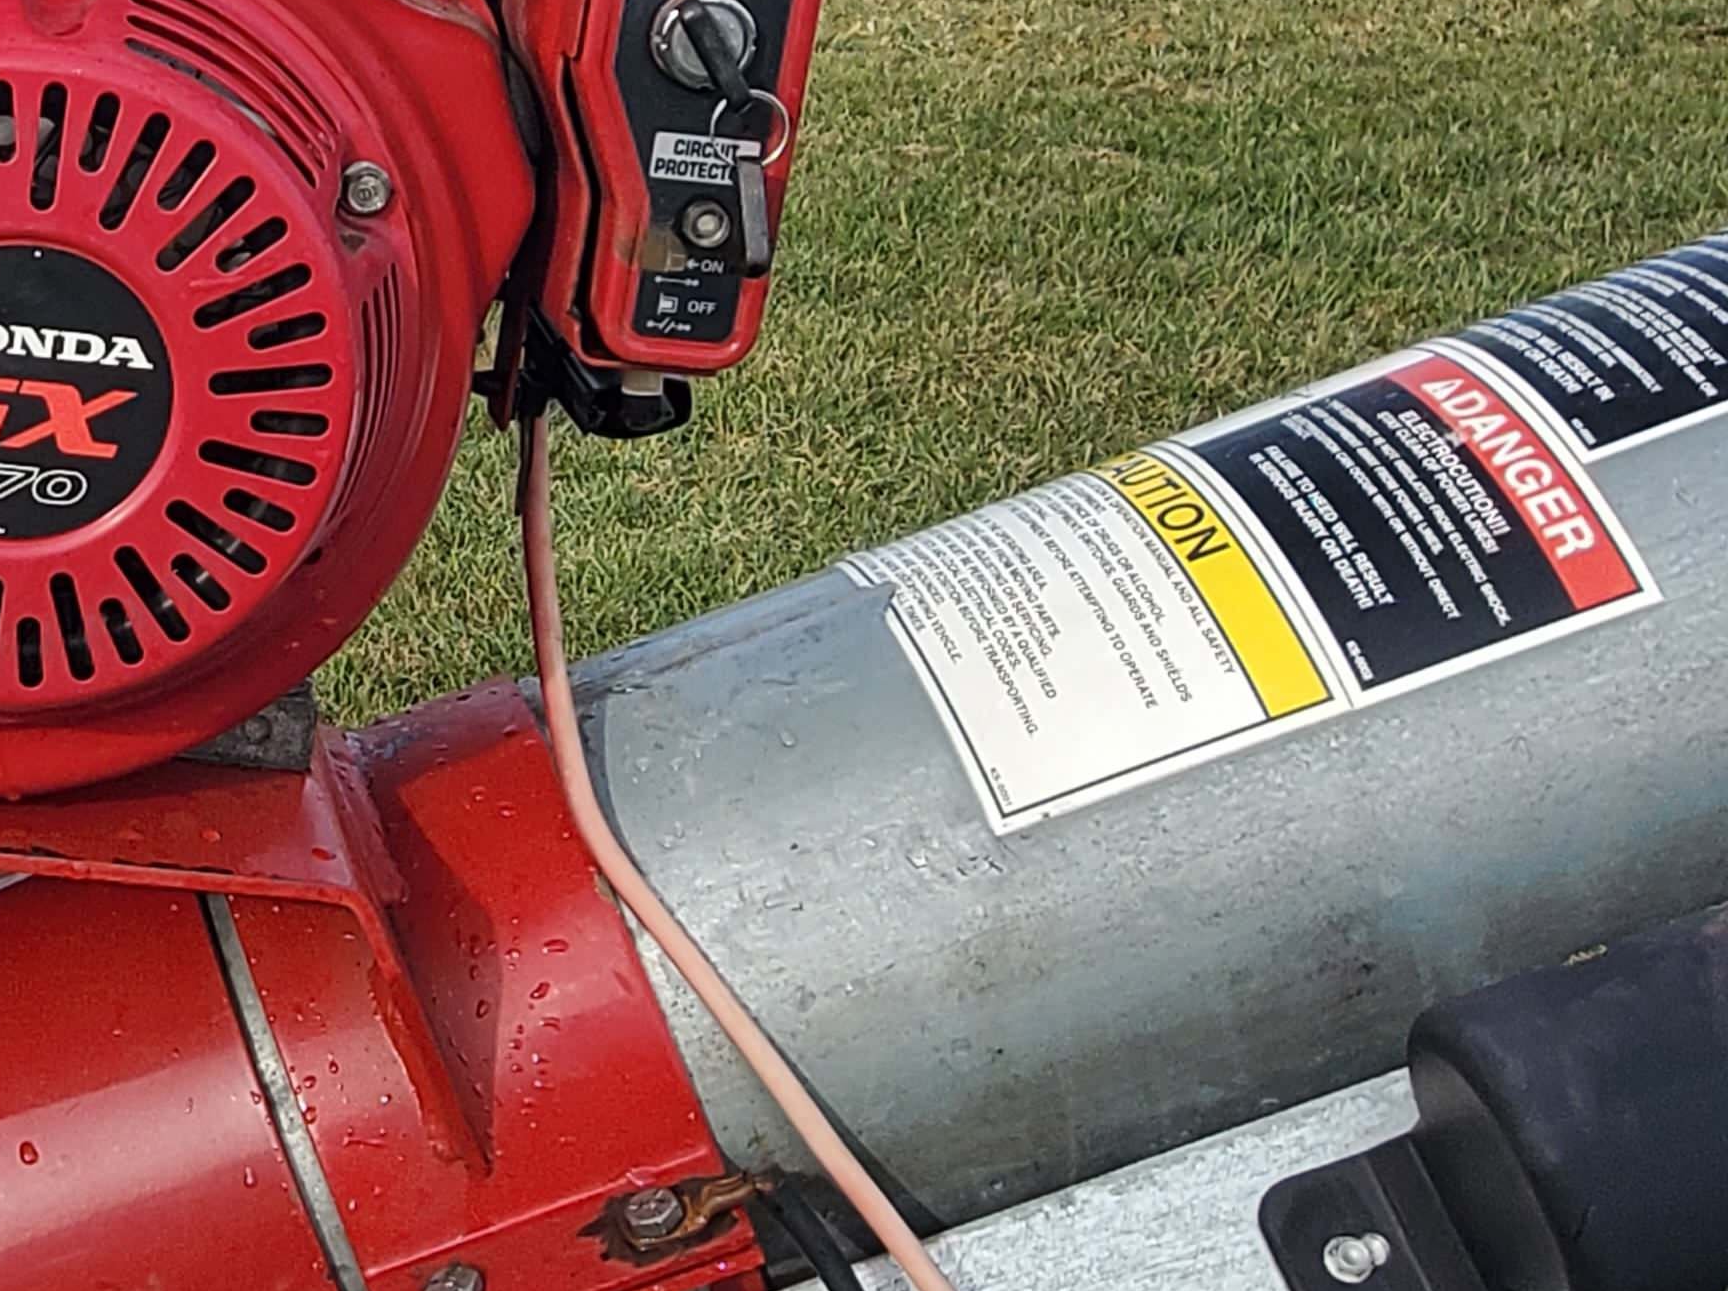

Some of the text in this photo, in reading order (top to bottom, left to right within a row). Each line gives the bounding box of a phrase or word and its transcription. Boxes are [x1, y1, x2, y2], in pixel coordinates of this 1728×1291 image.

[654, 159, 735, 181] PROTECT
[673, 139, 740, 157] CIRCUIT
[688, 301, 717, 314] OFF
[700, 260, 725, 274] ON
[1399, 411, 1510, 535] ELECTROCUTION!!
[1435, 472, 1471, 513] POWER
[1441, 389, 1595, 559] DANGER
[1291, 498, 1329, 537] INJURY
[1321, 539, 1342, 560] OR
[1334, 559, 1373, 608] DEATH!
[1296, 477, 1315, 492] TO
[1332, 521, 1358, 553] WILL
[1352, 553, 1394, 603] RESULT
[957, 578, 996, 628] ELECTRICAL
[992, 630, 1021, 670] CODES.
[1002, 586, 1018, 601] OR
[1012, 601, 1052, 657] SERVICING.
[1010, 568, 1038, 603] MOVING
[1033, 604, 1060, 639] PARTS.
[1117, 557, 1133, 571] OR
[1128, 573, 1165, 623] ALCOHOL.
[1172, 581, 1192, 603] AND
[1188, 606, 1205, 626] ALL
[1201, 628, 1235, 672] SAFETY
[958, 606, 988, 643] BEFORE
[984, 644, 1038, 734] TRANSPORTING.
[1002, 615, 1017, 627] BY
[1011, 631, 1022, 639] A
[1017, 639, 1056, 698] QUALIFIED
[1069, 571, 1114, 633] ATTEMPTING
[1109, 633, 1125, 650] TO
[1120, 652, 1157, 708] OPERATE
[1112, 578, 1146, 620] GUARDS
[1140, 623, 1161, 647] AND
[1156, 649, 1192, 702] SHIELDS
